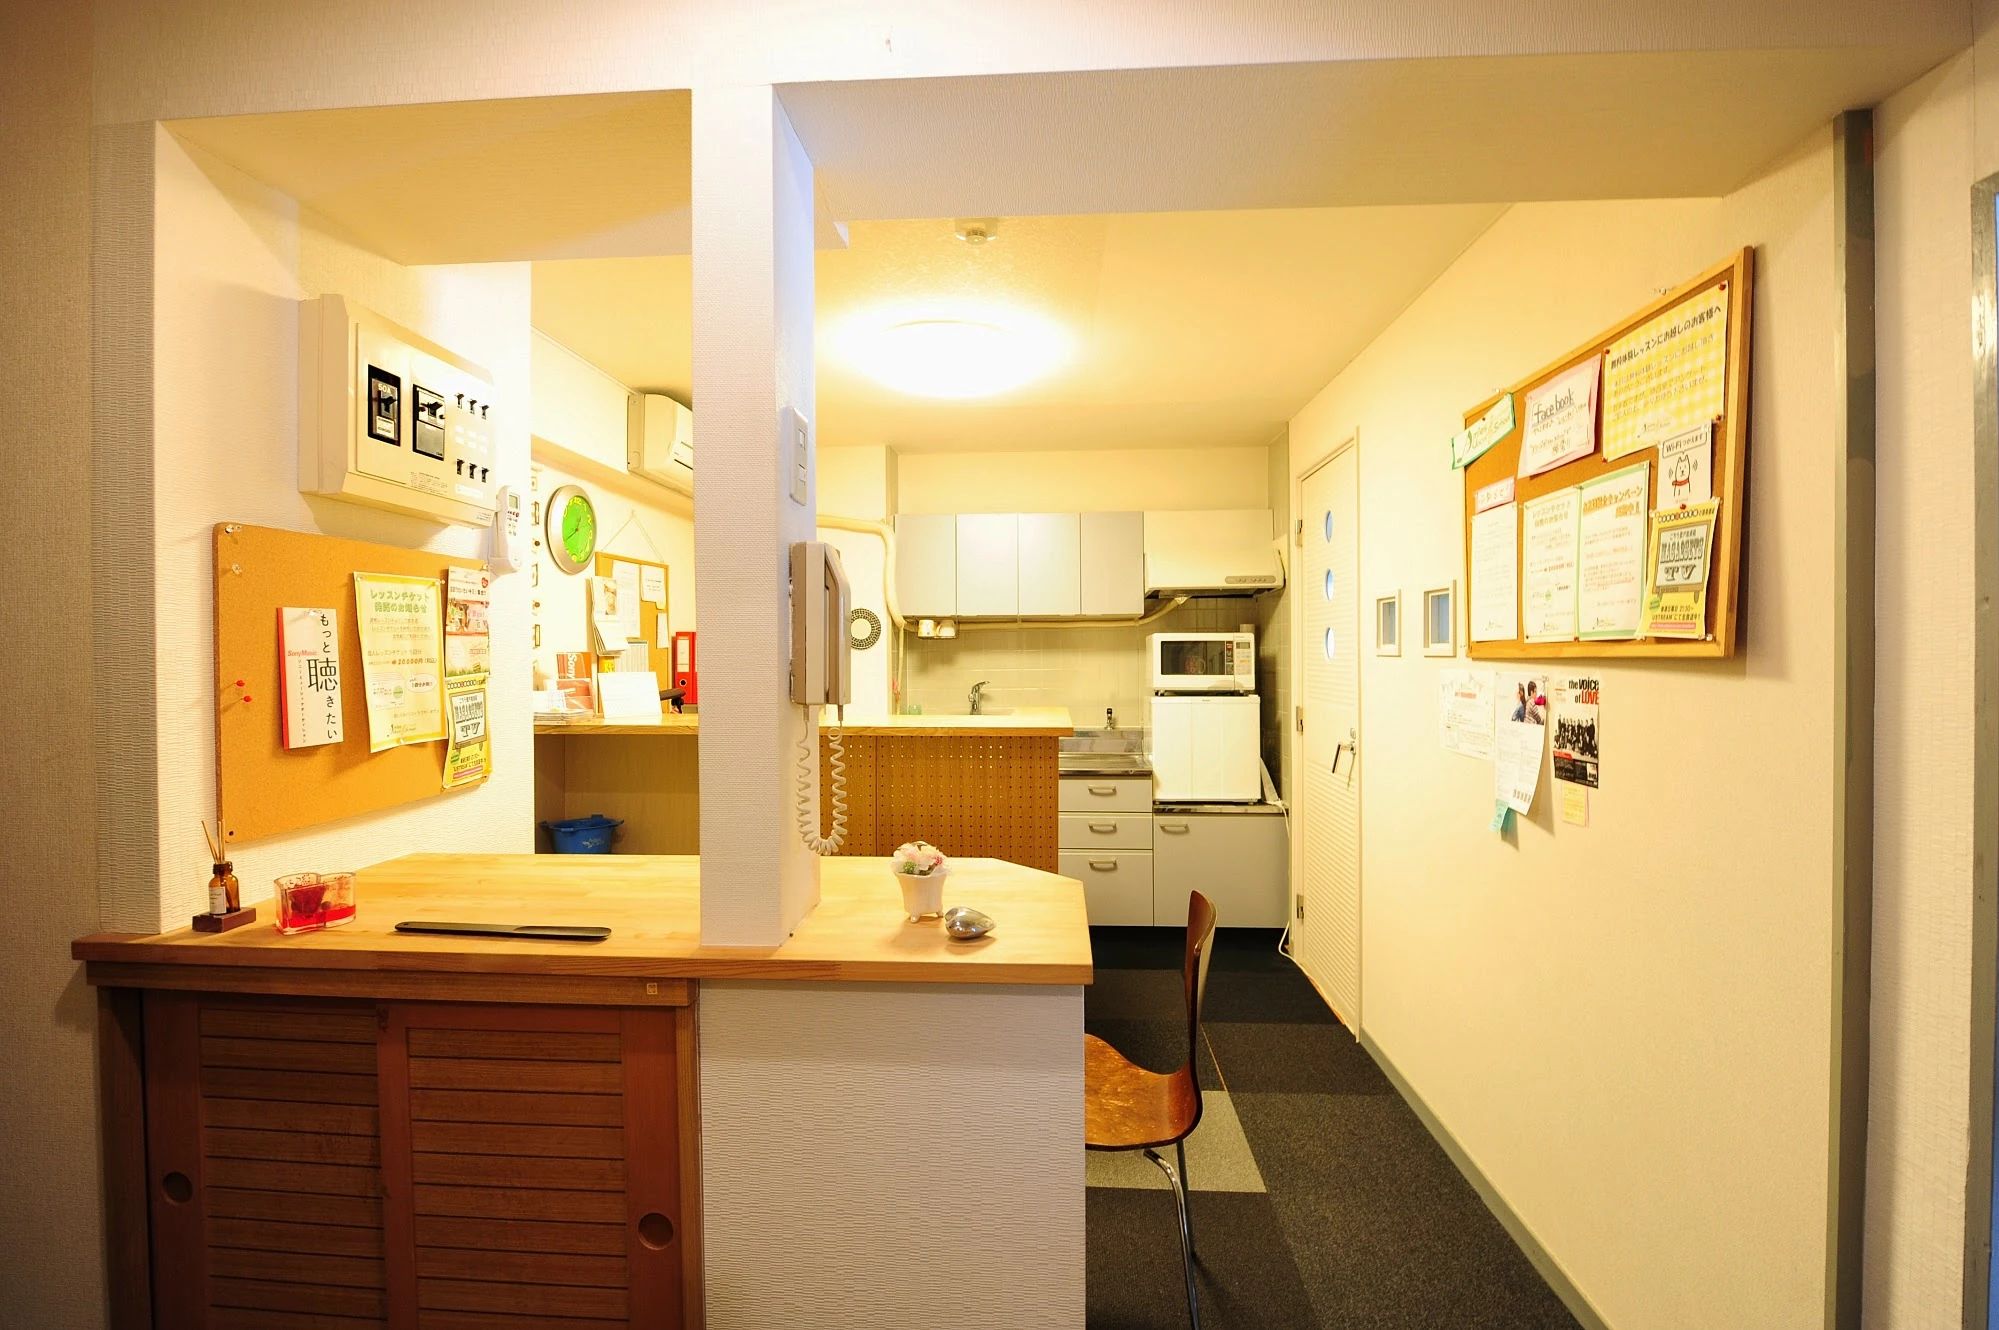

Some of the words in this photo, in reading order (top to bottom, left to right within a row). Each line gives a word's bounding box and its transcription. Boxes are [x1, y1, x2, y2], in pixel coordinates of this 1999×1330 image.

[377, 383, 392, 395] 50A
[306, 613, 338, 740] もっと聴きたい
[1568, 679, 1578, 690] the
[1578, 676, 1599, 691] voice
[1574, 694, 1581, 704] of
[1581, 690, 1599, 705] LOVE
